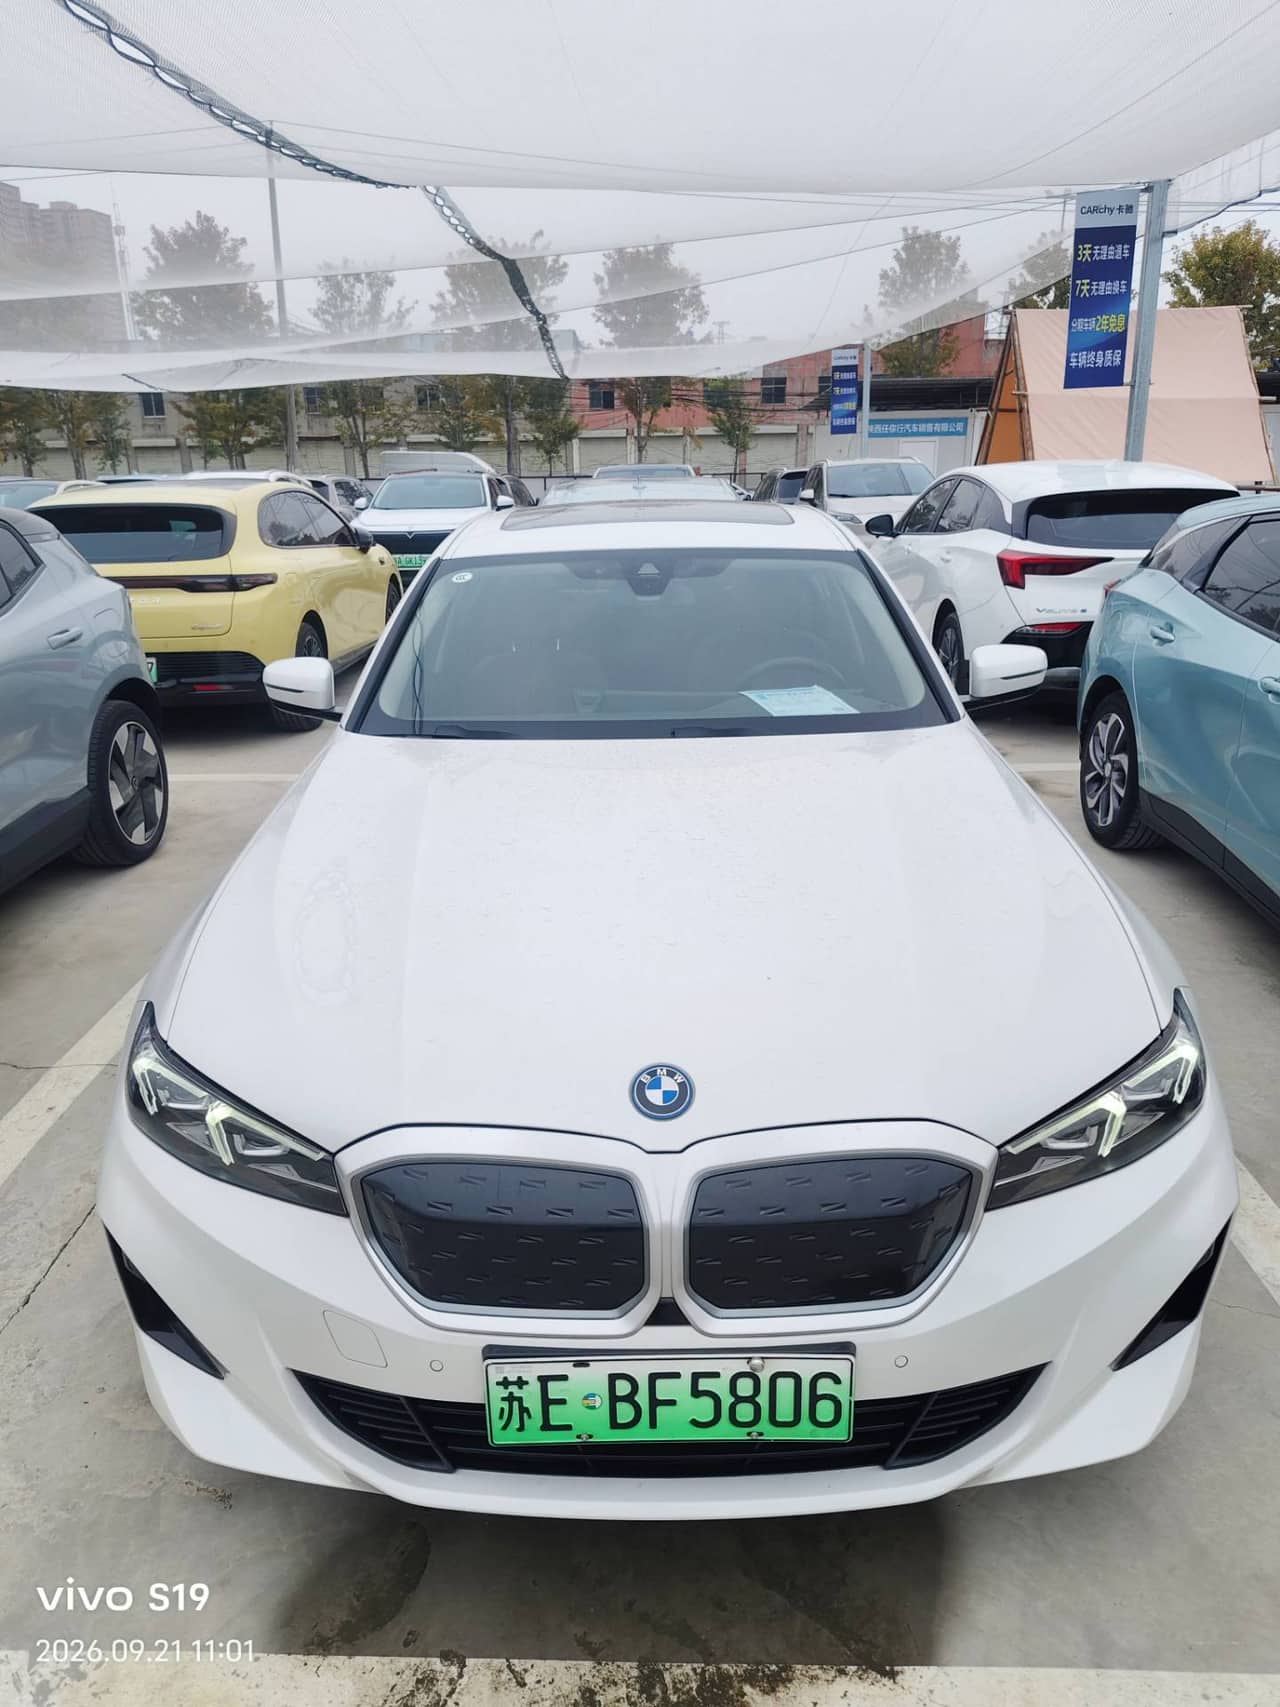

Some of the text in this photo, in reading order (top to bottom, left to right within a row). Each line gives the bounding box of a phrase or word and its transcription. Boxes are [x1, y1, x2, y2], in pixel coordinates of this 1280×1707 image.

[1080, 205, 1116, 216] CARchy
[1069, 350, 1122, 368] 车辆终身质保
[640, 1068, 686, 1084] BMW
[496, 1371, 842, 1432] 苏E BF5806
